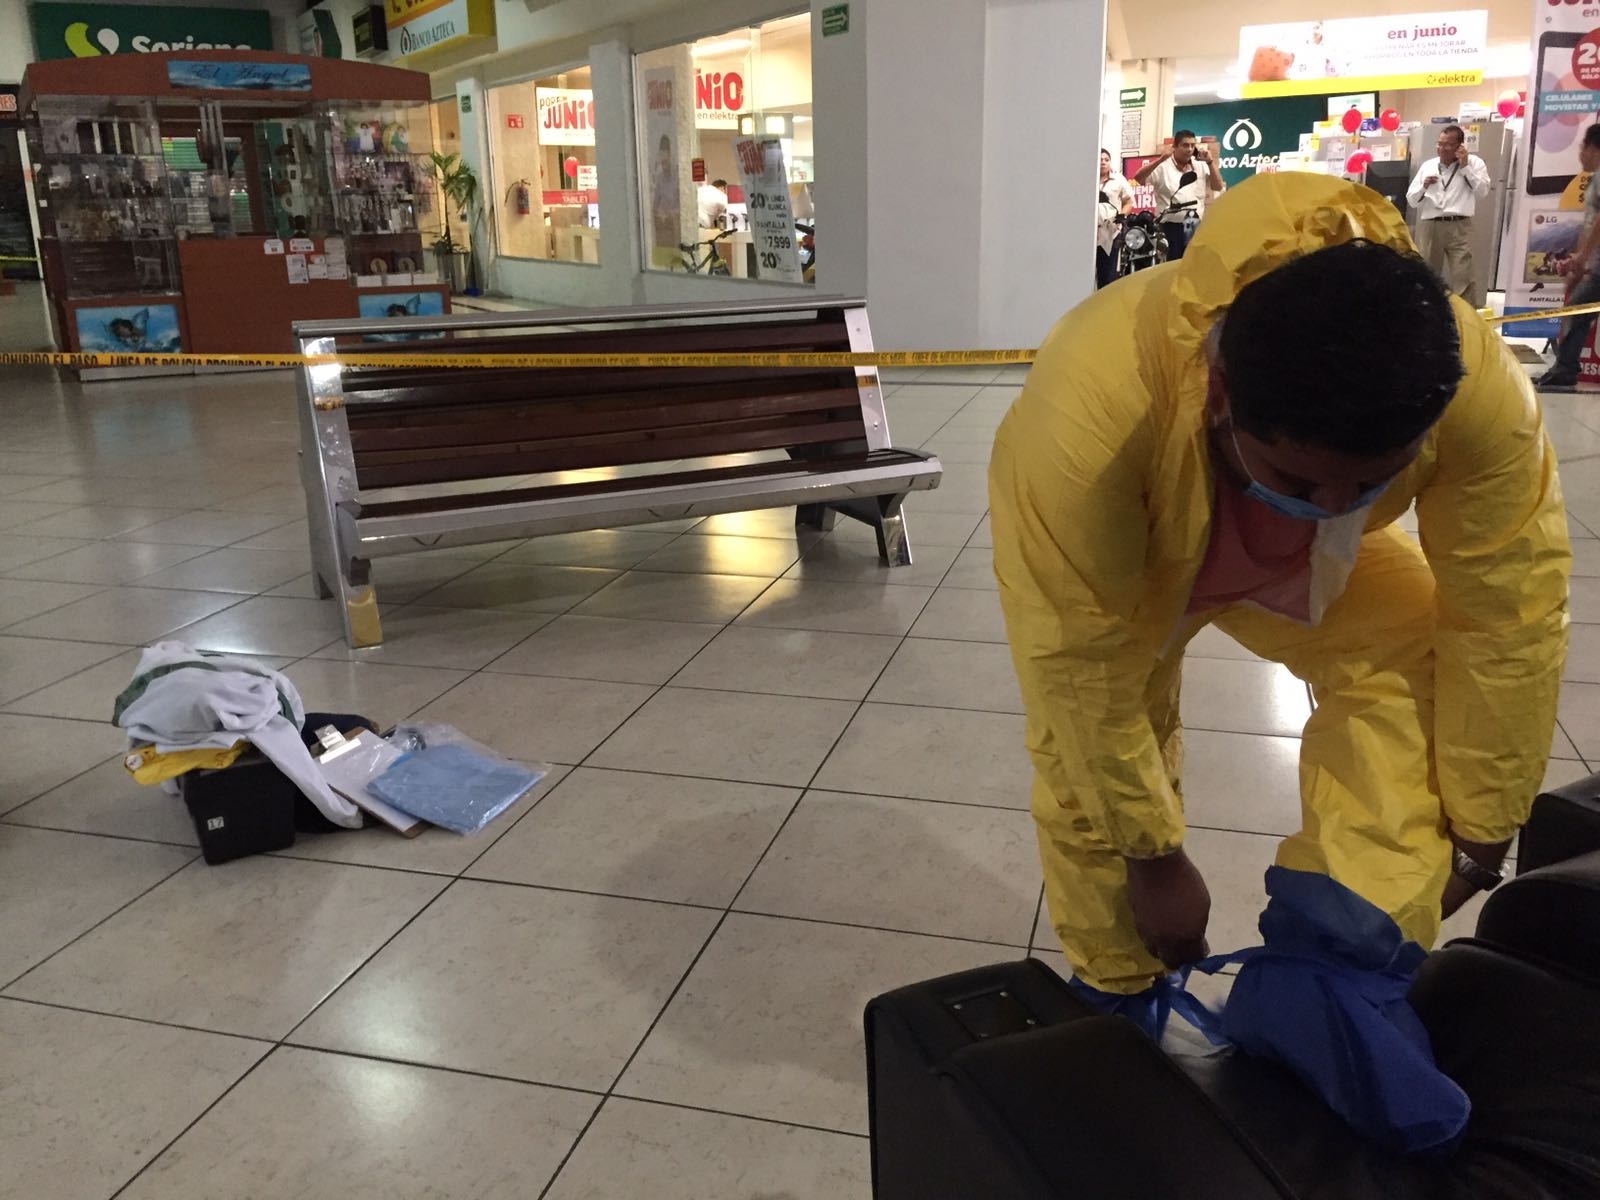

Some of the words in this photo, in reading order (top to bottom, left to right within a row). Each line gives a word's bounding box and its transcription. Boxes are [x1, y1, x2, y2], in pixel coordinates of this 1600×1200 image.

[411, 30, 432, 52] BANCO
[431, 20, 456, 43] AZTECA
[1387, 29, 1408, 40] en
[1412, 22, 1458, 41] junio
[1450, 47, 1479, 55] TIENDA
[1438, 73, 1476, 84] elektra
[1544, 103, 1589, 112] MOVISTAR
[1546, 215, 1558, 224] LG
